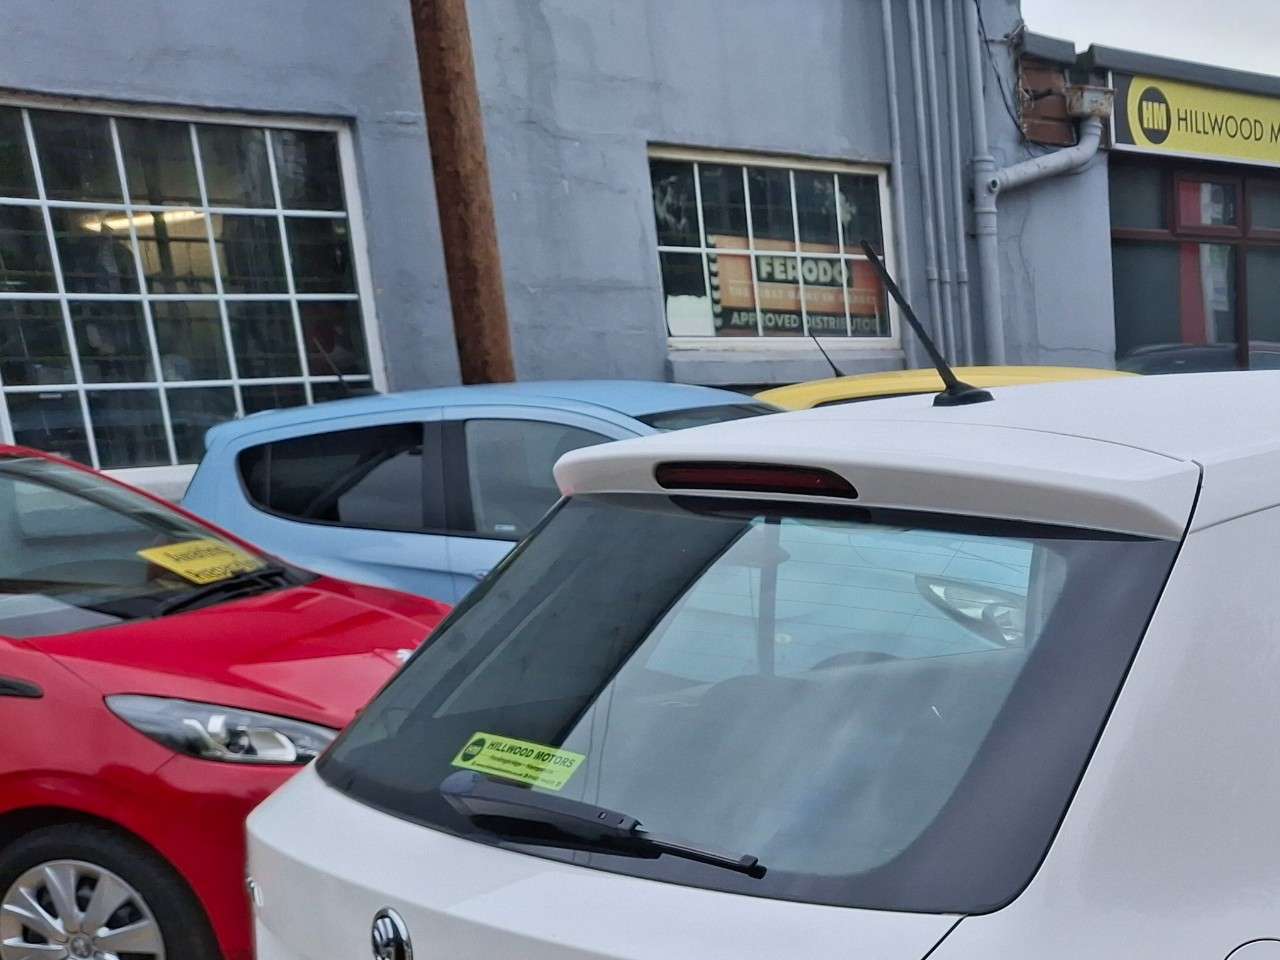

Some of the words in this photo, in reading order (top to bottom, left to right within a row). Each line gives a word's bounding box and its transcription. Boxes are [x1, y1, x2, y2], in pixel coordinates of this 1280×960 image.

[1177, 107, 1264, 142] HILLWOOD
[487, 741, 535, 758] HILLWOOD
[534, 751, 576, 769] MOTORS
